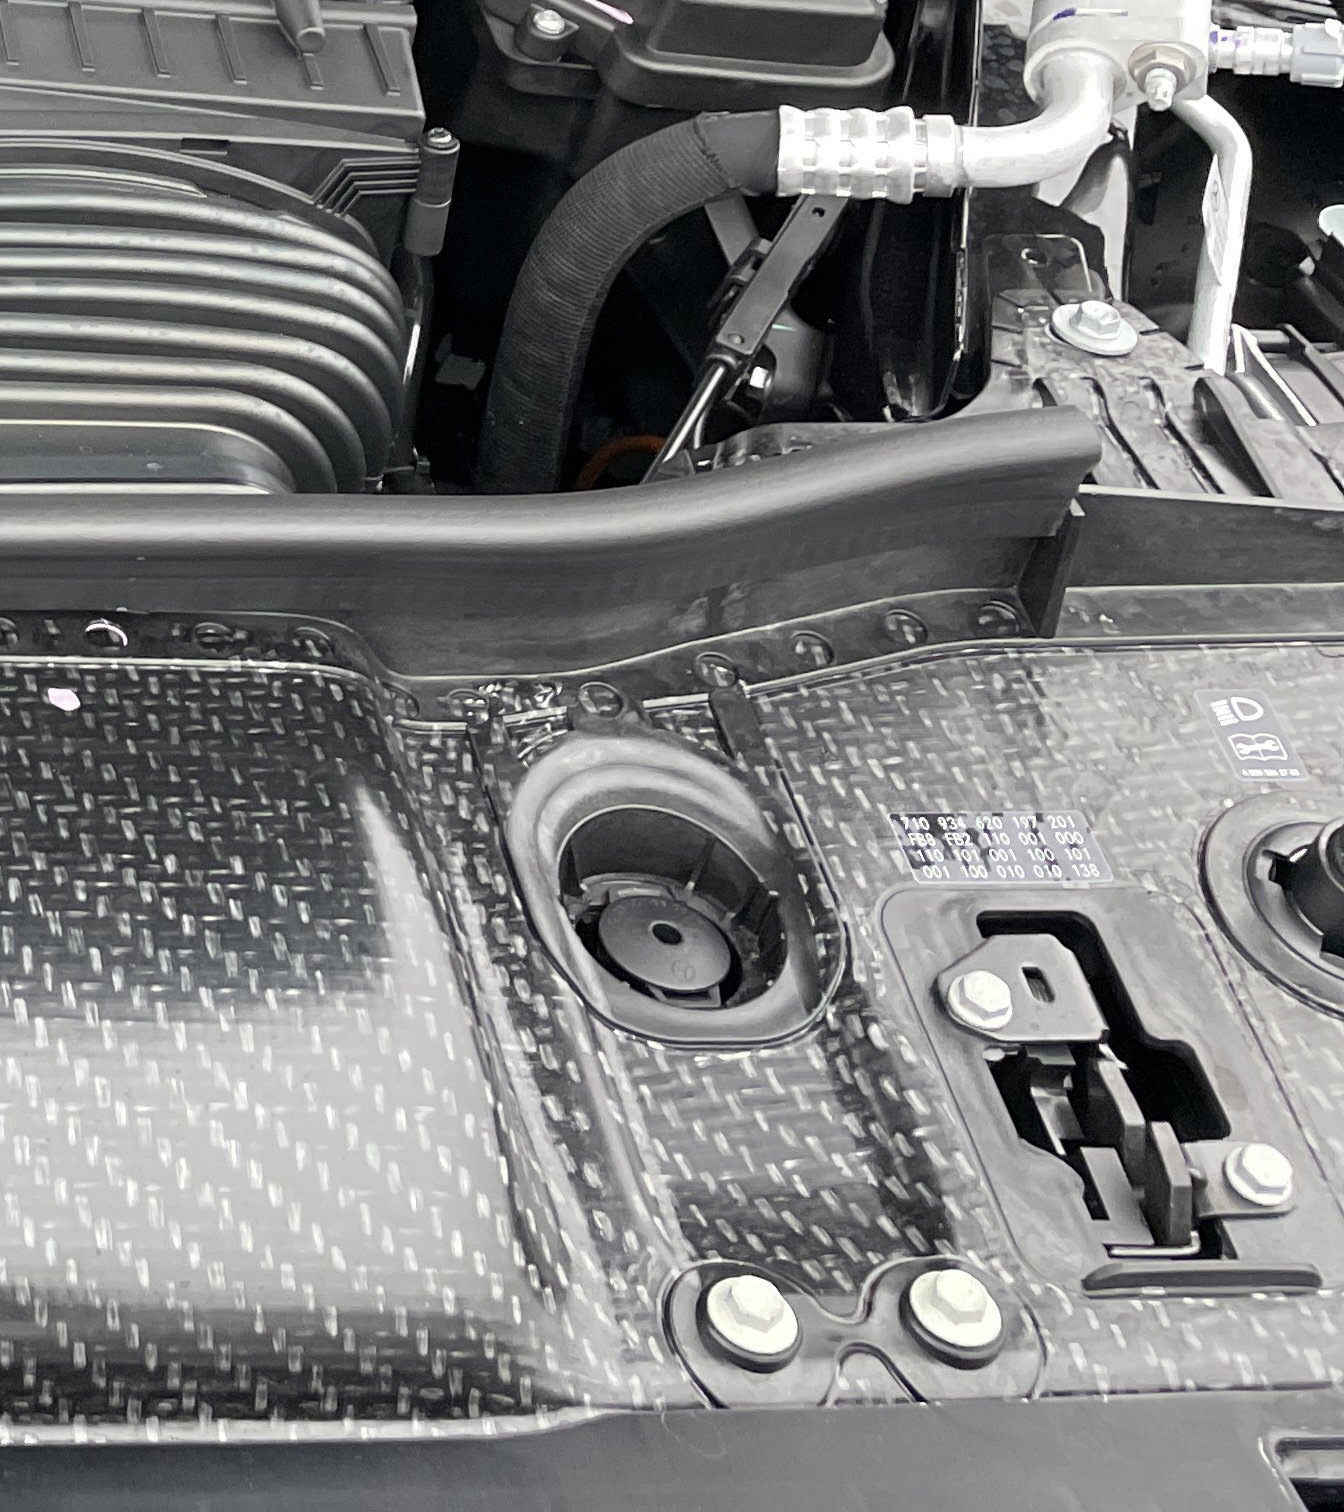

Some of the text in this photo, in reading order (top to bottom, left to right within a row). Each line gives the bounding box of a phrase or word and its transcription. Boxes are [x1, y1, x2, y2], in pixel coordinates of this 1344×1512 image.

[900, 816, 930, 830] 710
[976, 816, 1003, 829] 620
[1012, 815, 1037, 829] 197
[1047, 815, 1075, 829] 201
[944, 832, 974, 846] FB2
[983, 832, 1010, 845] 110
[1019, 832, 1046, 845] 001
[1055, 831, 1084, 844] 000
[917, 848, 1091, 862] 110 101 001 100 101
[923, 864, 1100, 878] 001 100 010 010 138
